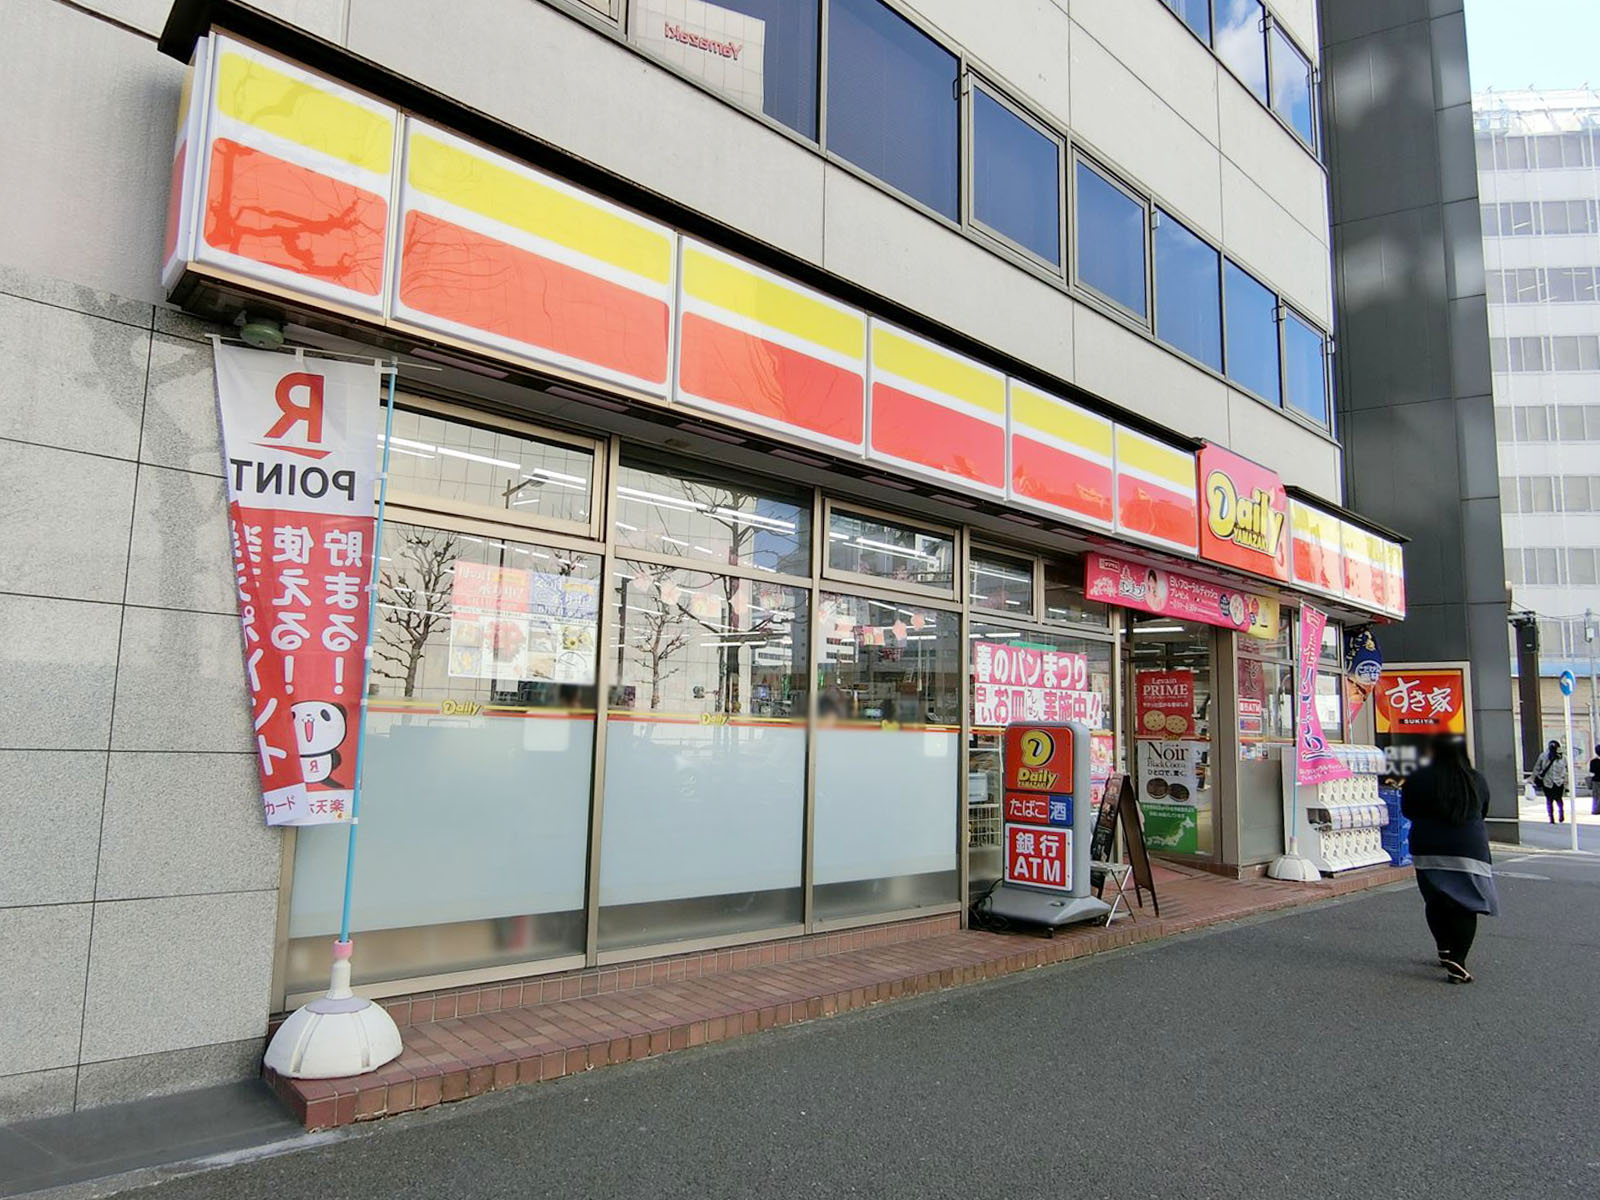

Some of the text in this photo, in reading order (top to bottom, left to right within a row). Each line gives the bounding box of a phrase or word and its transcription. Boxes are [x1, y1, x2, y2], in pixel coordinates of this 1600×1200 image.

[1206, 469, 1285, 558] Daily
[976, 644, 1087, 690] 春のパンまつり
[1143, 684, 1188, 696] PRIME
[1385, 677, 1453, 717] すき家
[442, 699, 481, 716] Daily
[1147, 741, 1188, 761] Noir
[1018, 767, 1058, 790] Daily
[1009, 798, 1047, 818] たばこ
[1050, 800, 1067, 821] 酒
[1015, 831, 1060, 858] 銀行
[1013, 855, 1061, 883] ATM
